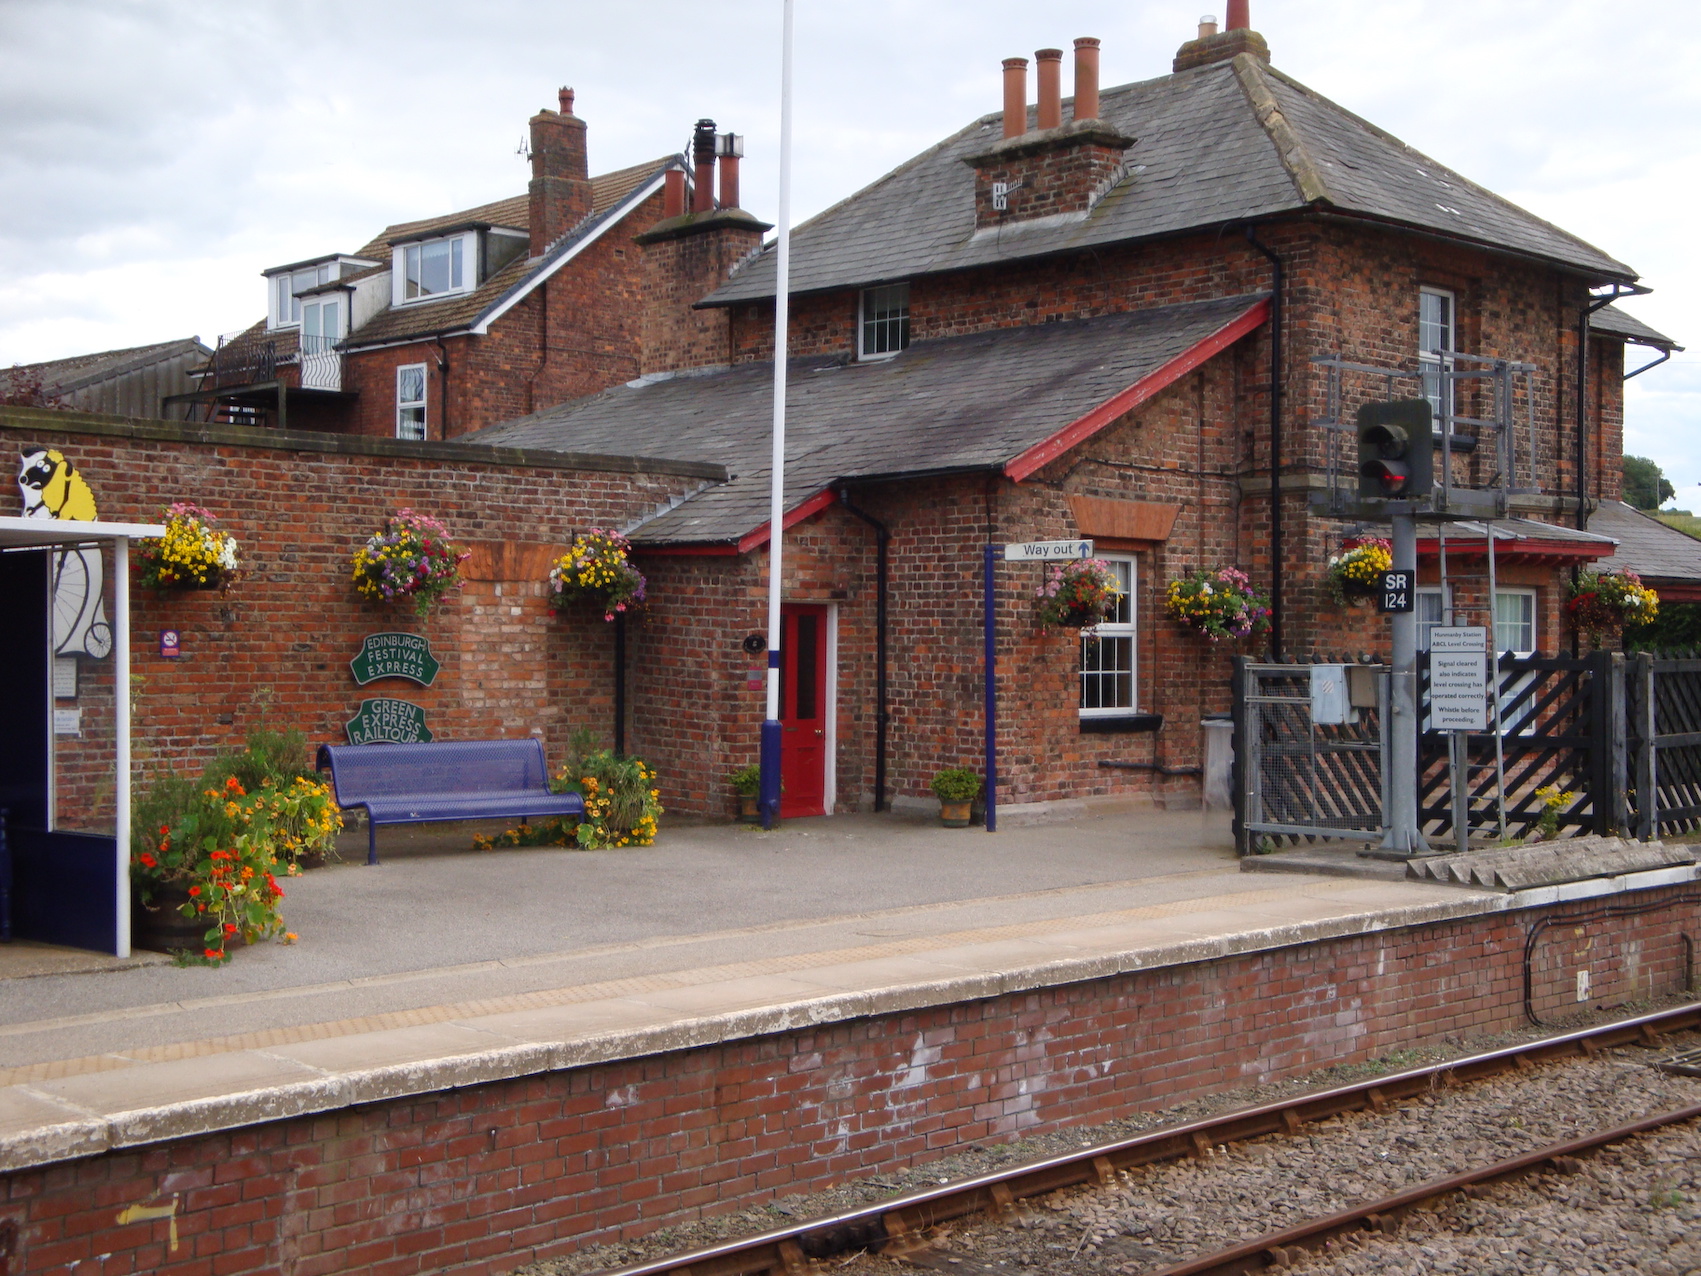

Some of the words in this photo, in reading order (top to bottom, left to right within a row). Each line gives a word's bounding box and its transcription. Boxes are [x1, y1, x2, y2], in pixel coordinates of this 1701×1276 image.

[1024, 544, 1049, 556] Way
[1053, 543, 1072, 554] out
[1385, 574, 1407, 590] SR
[1385, 592, 1407, 608] 124
[367, 636, 427, 652] EDINBURGH
[368, 648, 424, 664] FESTIVAL
[368, 661, 424, 677] EXPRESS
[372, 700, 416, 719] GREEN
[362, 714, 421, 734] EXPRESS
[353, 726, 426, 744] RAILTOUR
